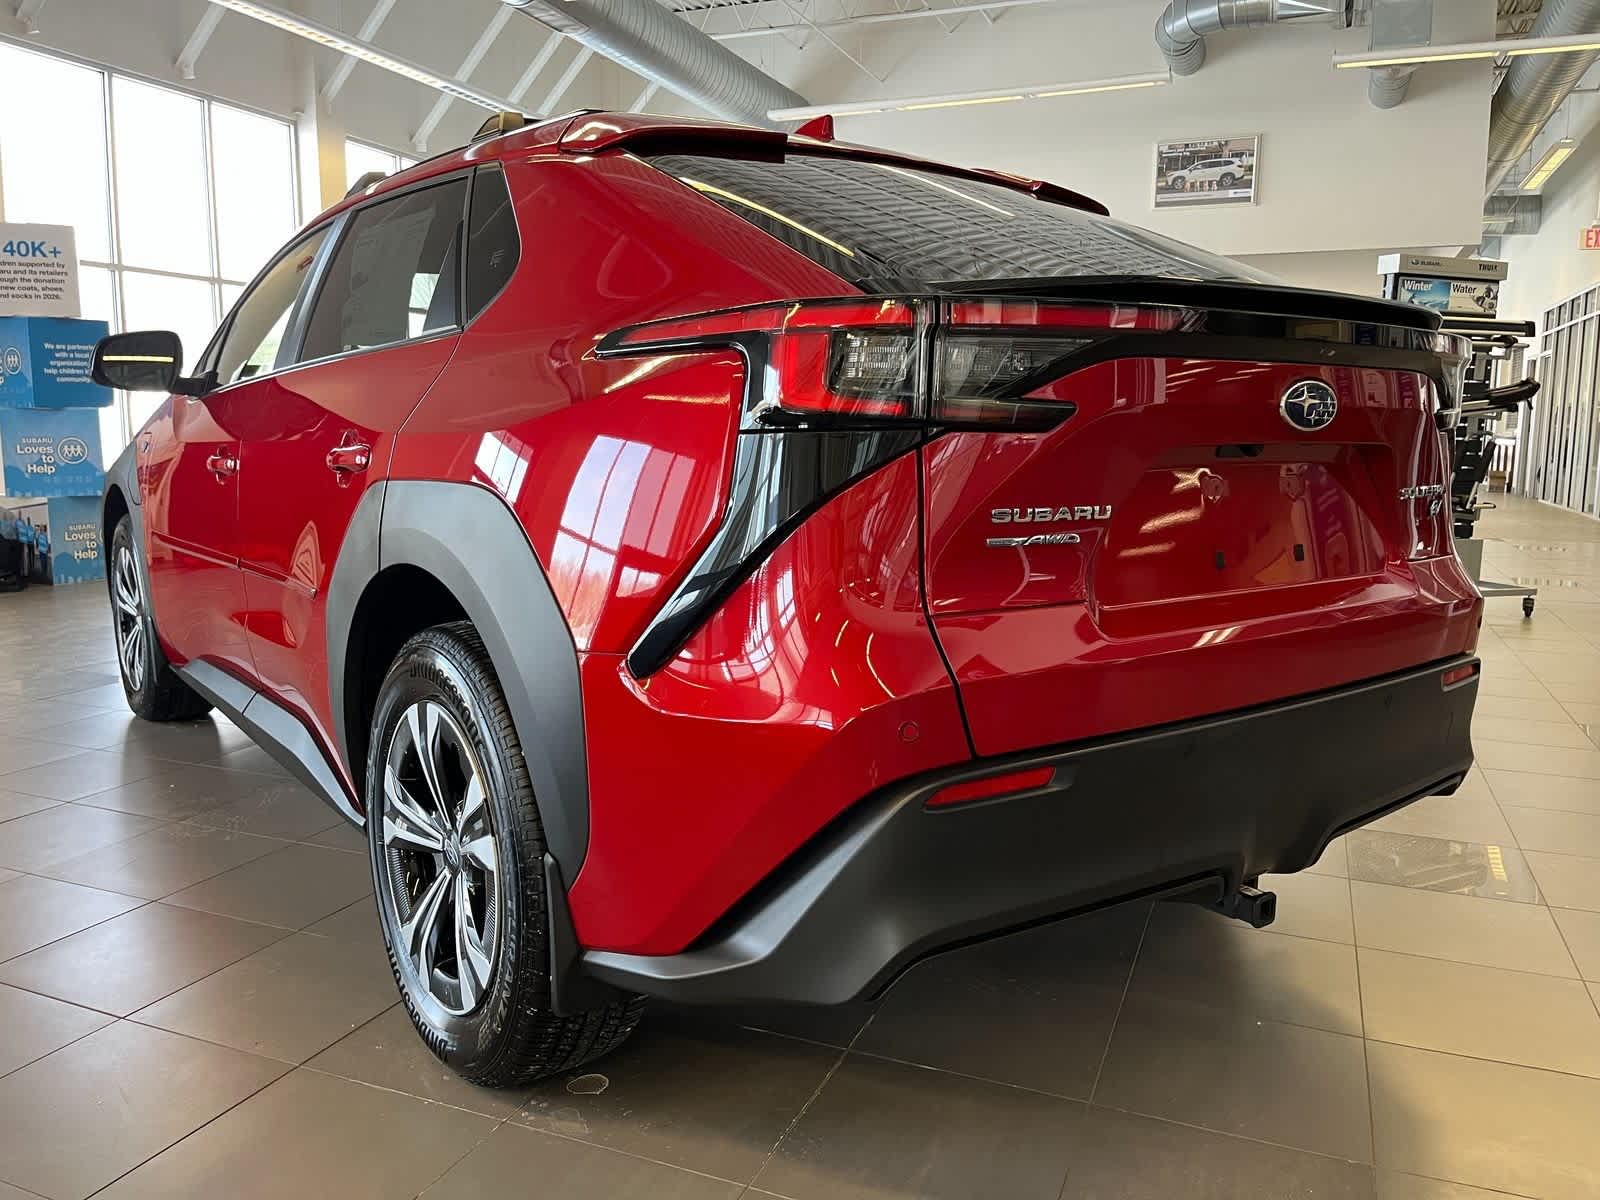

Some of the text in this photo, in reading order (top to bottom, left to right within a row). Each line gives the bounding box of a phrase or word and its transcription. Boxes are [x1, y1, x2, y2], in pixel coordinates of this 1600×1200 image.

[1586, 230, 1600, 248] EX
[3, 240, 62, 257] 40K+
[1404, 279, 1433, 291] Winter
[1453, 283, 1477, 294] Water
[16, 444, 54, 454] Loves
[41, 454, 54, 464] to
[27, 463, 56, 475] Help
[991, 504, 1112, 523] SUBARU
[64, 531, 97, 541] Loves
[1024, 533, 1081, 546] AWD
[86, 540, 97, 549] to
[74, 548, 98, 560] Help
